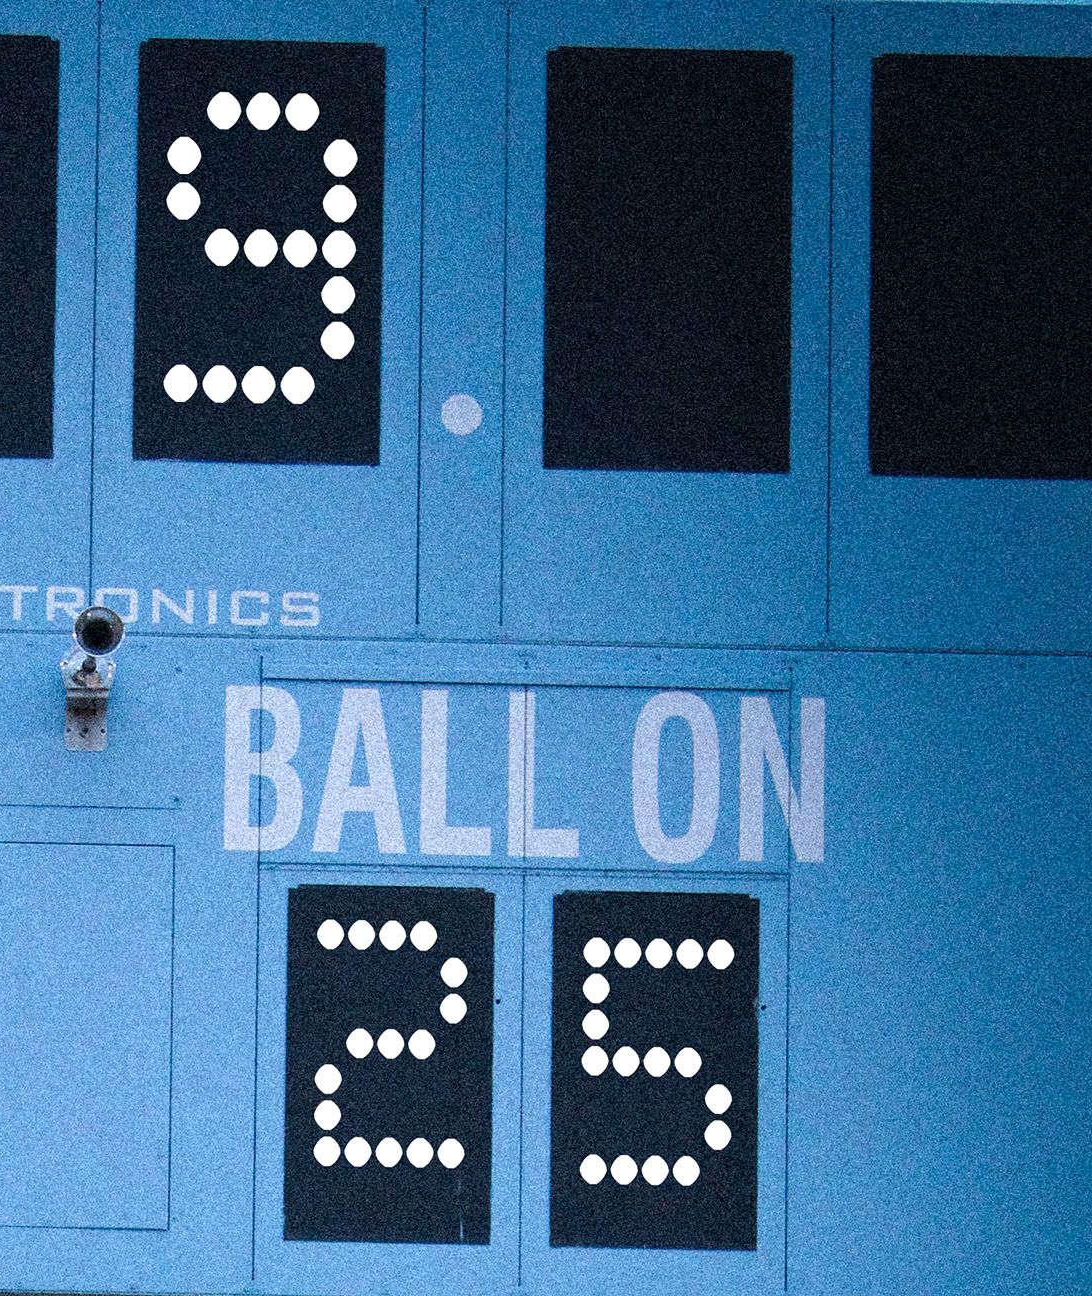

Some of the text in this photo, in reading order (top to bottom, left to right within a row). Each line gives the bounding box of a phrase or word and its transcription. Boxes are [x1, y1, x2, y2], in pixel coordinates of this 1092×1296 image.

[222, 685, 826, 864] BALL ON
[312, 917, 733, 1187] 25
